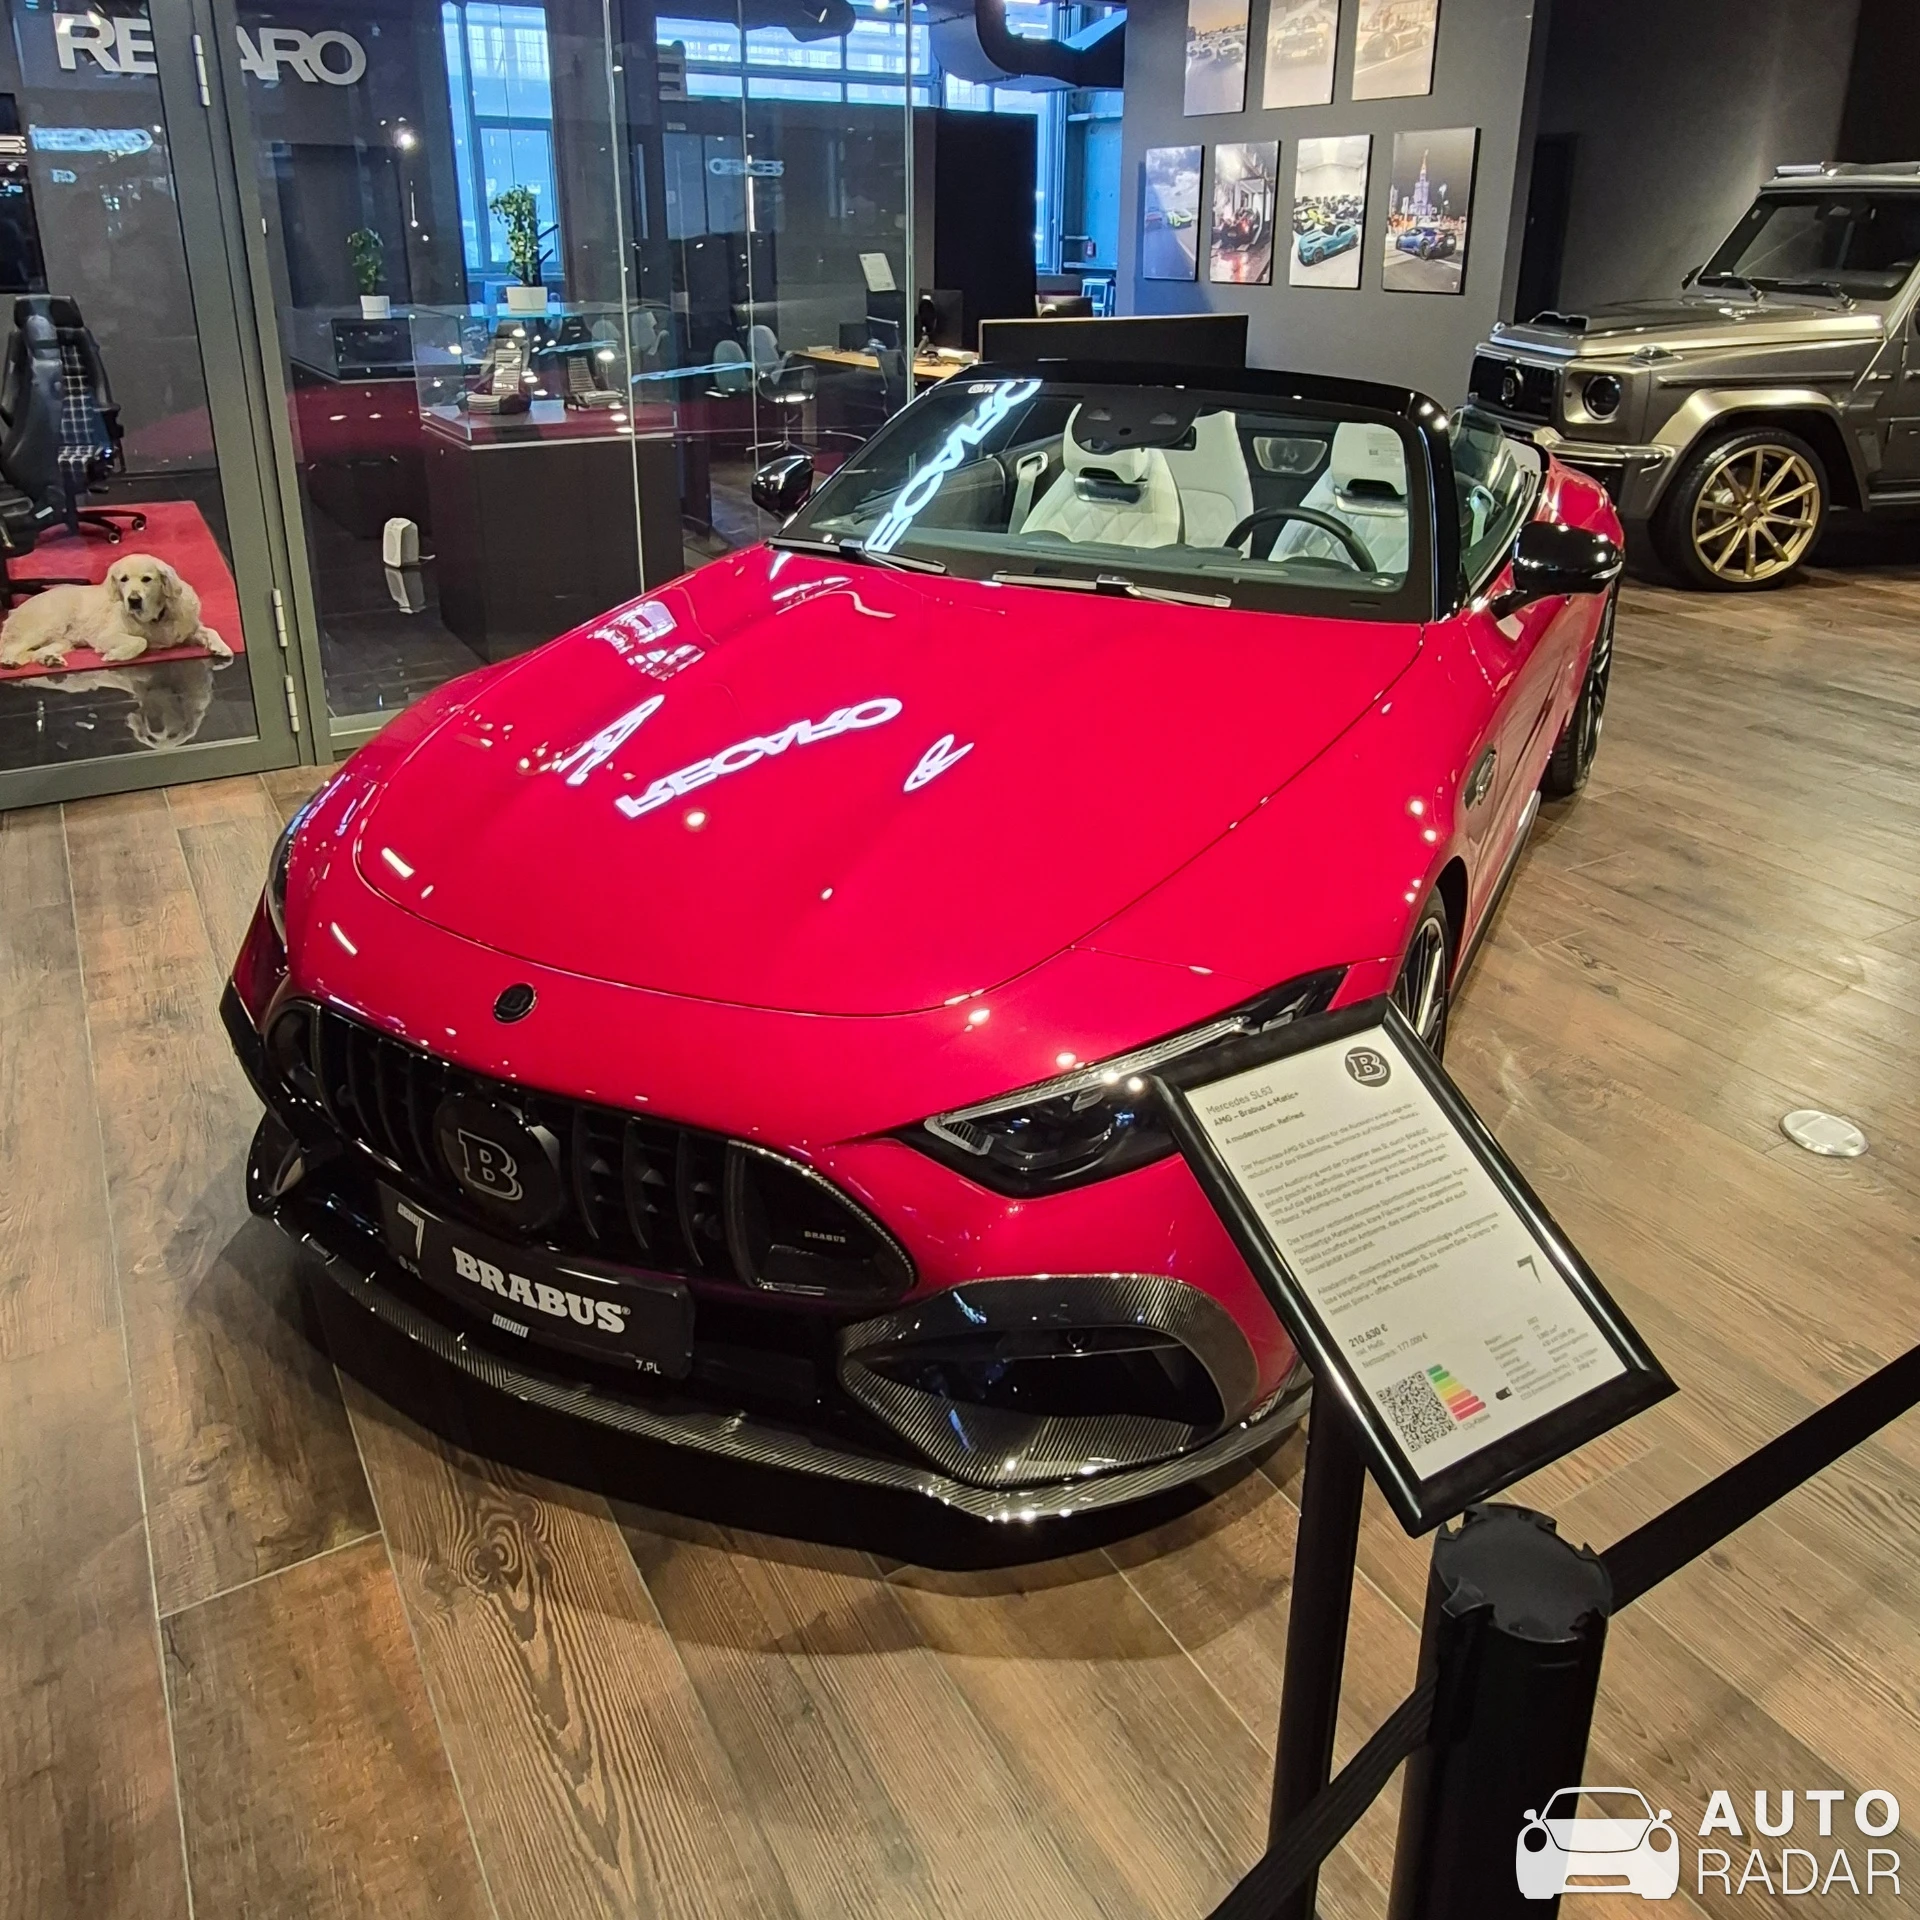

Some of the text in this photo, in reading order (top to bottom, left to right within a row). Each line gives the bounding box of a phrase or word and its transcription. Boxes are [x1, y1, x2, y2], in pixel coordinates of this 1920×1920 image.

[1347, 1051, 1388, 1082] B
[1205, 1085, 1272, 1113] Mercedes SL63
[1238, 1104, 1266, 1117] Brabus
[1231, 1129, 1259, 1142] modern
[457, 1127, 523, 1201] B
[1348, 1323, 1387, 1347] 210.630 €
